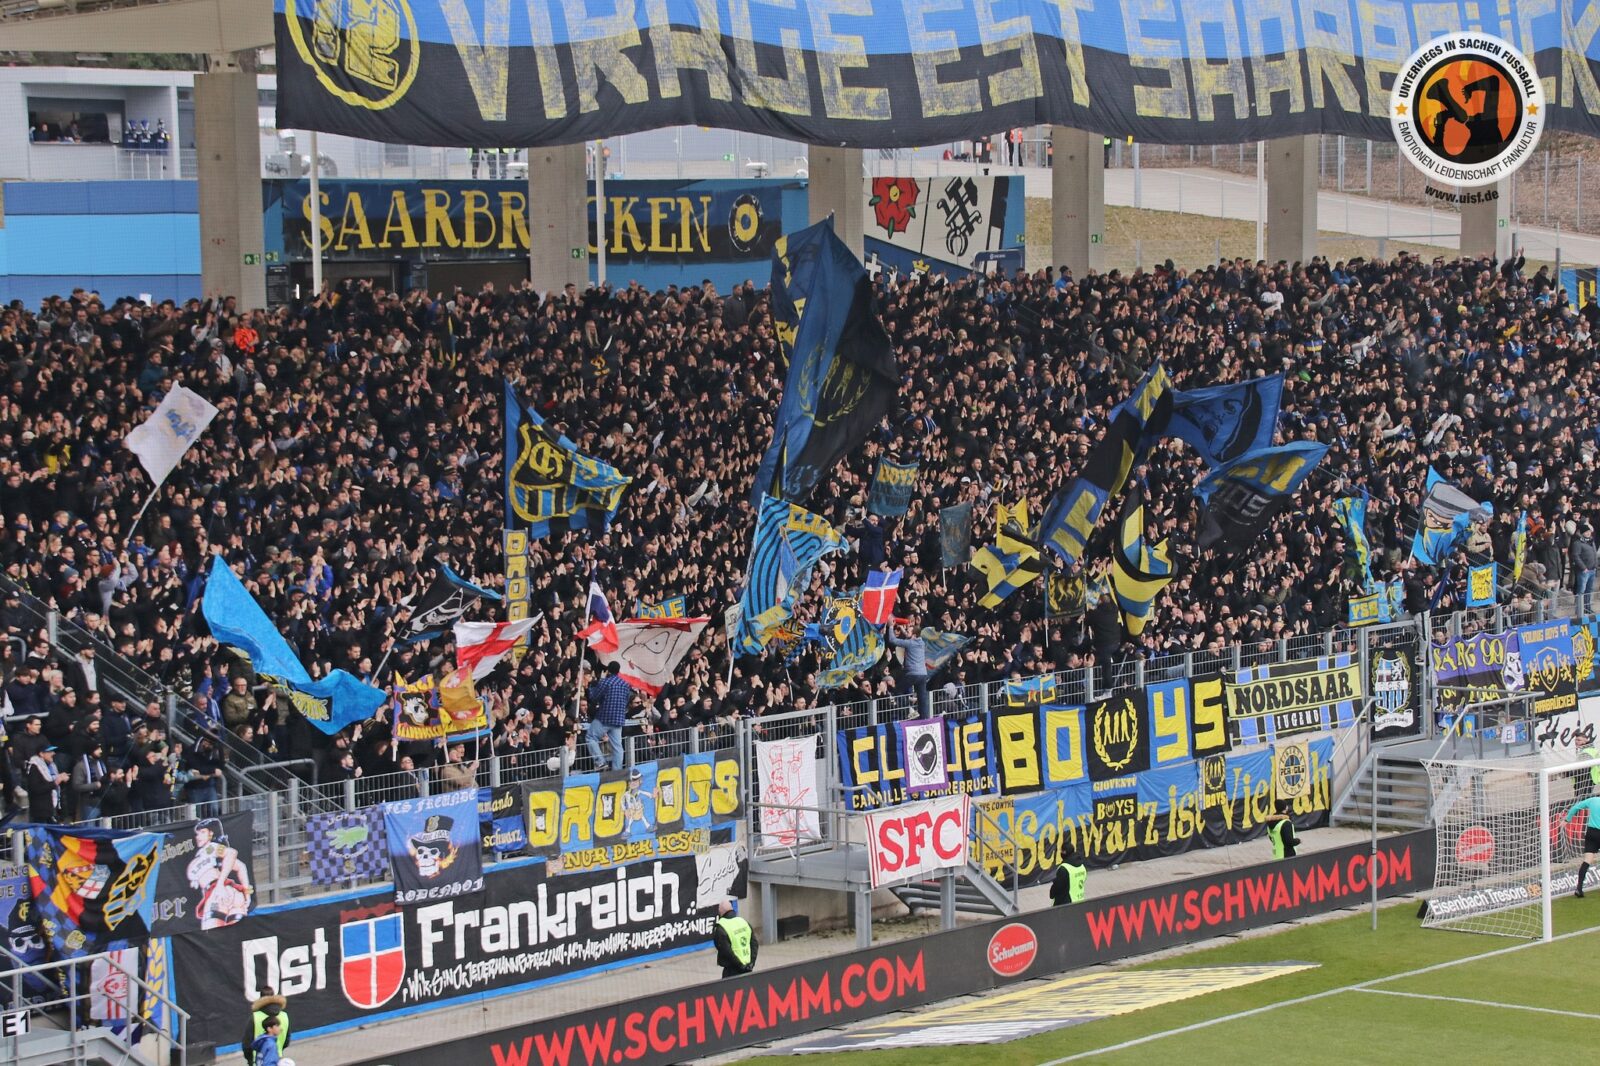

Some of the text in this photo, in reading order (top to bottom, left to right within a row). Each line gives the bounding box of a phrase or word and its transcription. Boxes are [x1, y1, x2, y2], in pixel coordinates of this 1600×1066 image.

[301, 189, 711, 253] SAARBRCKEN
[1233, 671, 1353, 715] NORDSAAR
[852, 721, 986, 785] CLUE
[564, 831, 692, 869] NUR DER FCS
[878, 809, 962, 873] SFC
[417, 860, 680, 968] Frankreich
[1086, 845, 1413, 951] WWW.SCHWAMM.COM
[1430, 891, 1490, 916] Eisenbach
[491, 949, 927, 1066] WWW.SCHWAMM.COM
